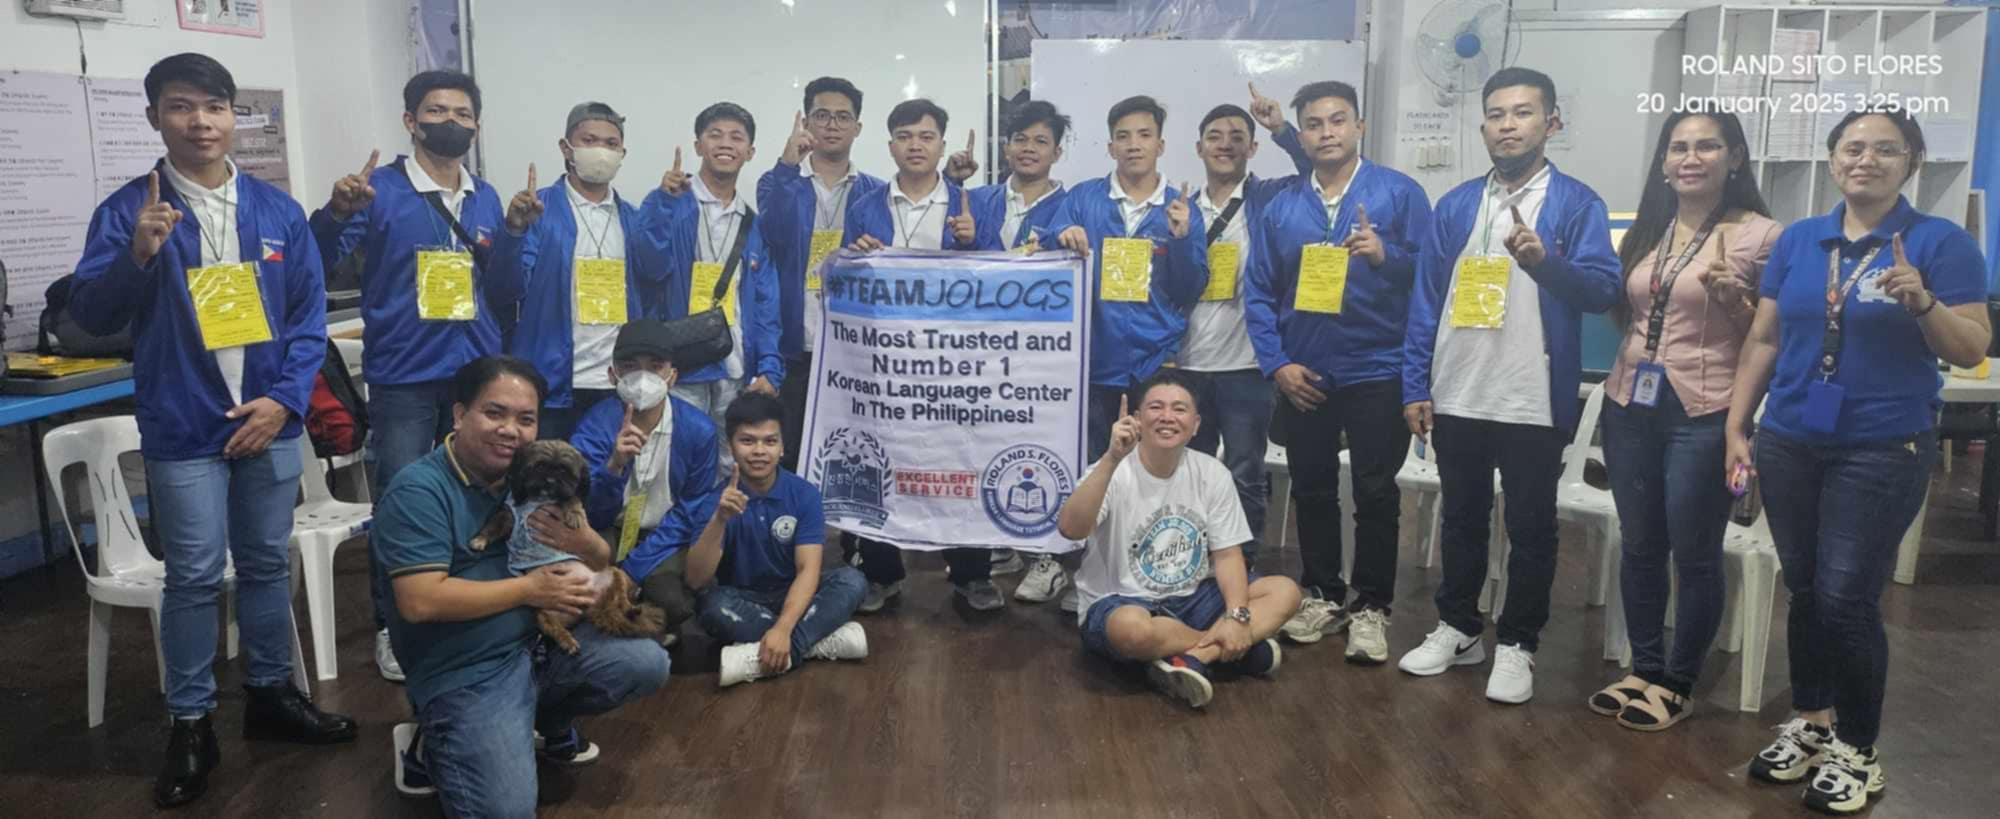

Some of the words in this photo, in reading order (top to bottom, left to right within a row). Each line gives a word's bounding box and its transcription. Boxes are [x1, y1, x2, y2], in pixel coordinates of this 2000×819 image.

[831, 320, 858, 344] The
[862, 328, 916, 349] Most
[923, 329, 1018, 351] Trusted
[1025, 331, 1072, 351] and
[872, 354, 986, 375] Number
[1000, 356, 1010, 376] 1
[827, 370, 881, 396] Korean
[887, 380, 992, 402] Language
[998, 382, 1073, 402] Center
[852, 397, 866, 416] In
[869, 400, 906, 420] The
[912, 403, 1034, 426] Philippines!
[896, 471, 977, 484] EXCELLENT
[987, 449, 1026, 487] ROLAND
[1038, 452, 1070, 490] FLORES
[898, 483, 974, 497] SERVICE
